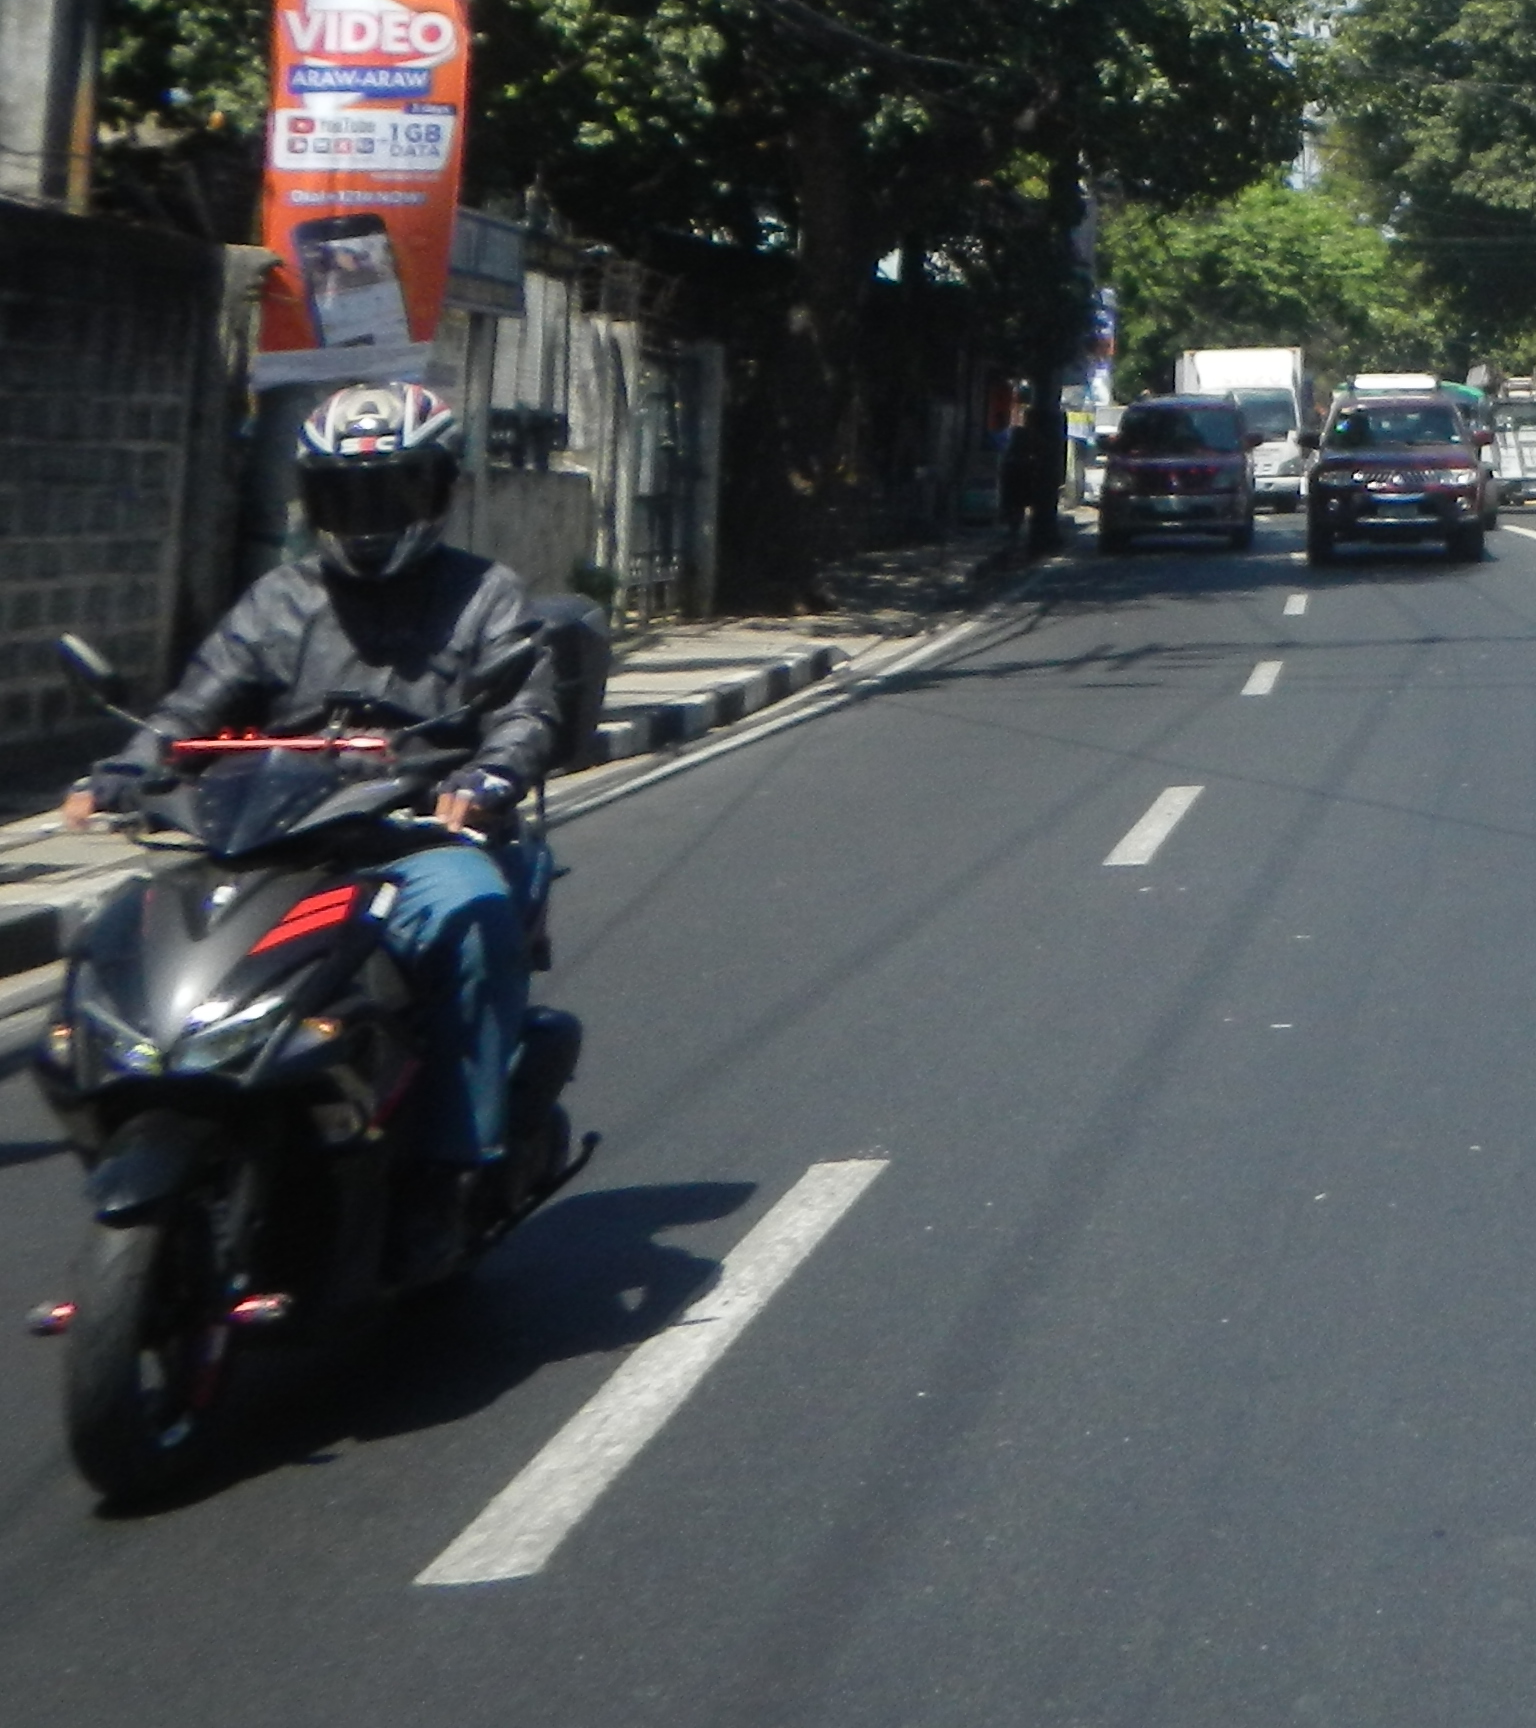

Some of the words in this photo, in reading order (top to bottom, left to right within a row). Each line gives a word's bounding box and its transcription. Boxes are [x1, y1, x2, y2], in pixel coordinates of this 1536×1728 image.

[283, 10, 455, 59] VIDEO
[291, 69, 429, 88] ARAW-ARAW
[389, 144, 441, 158] DATA
